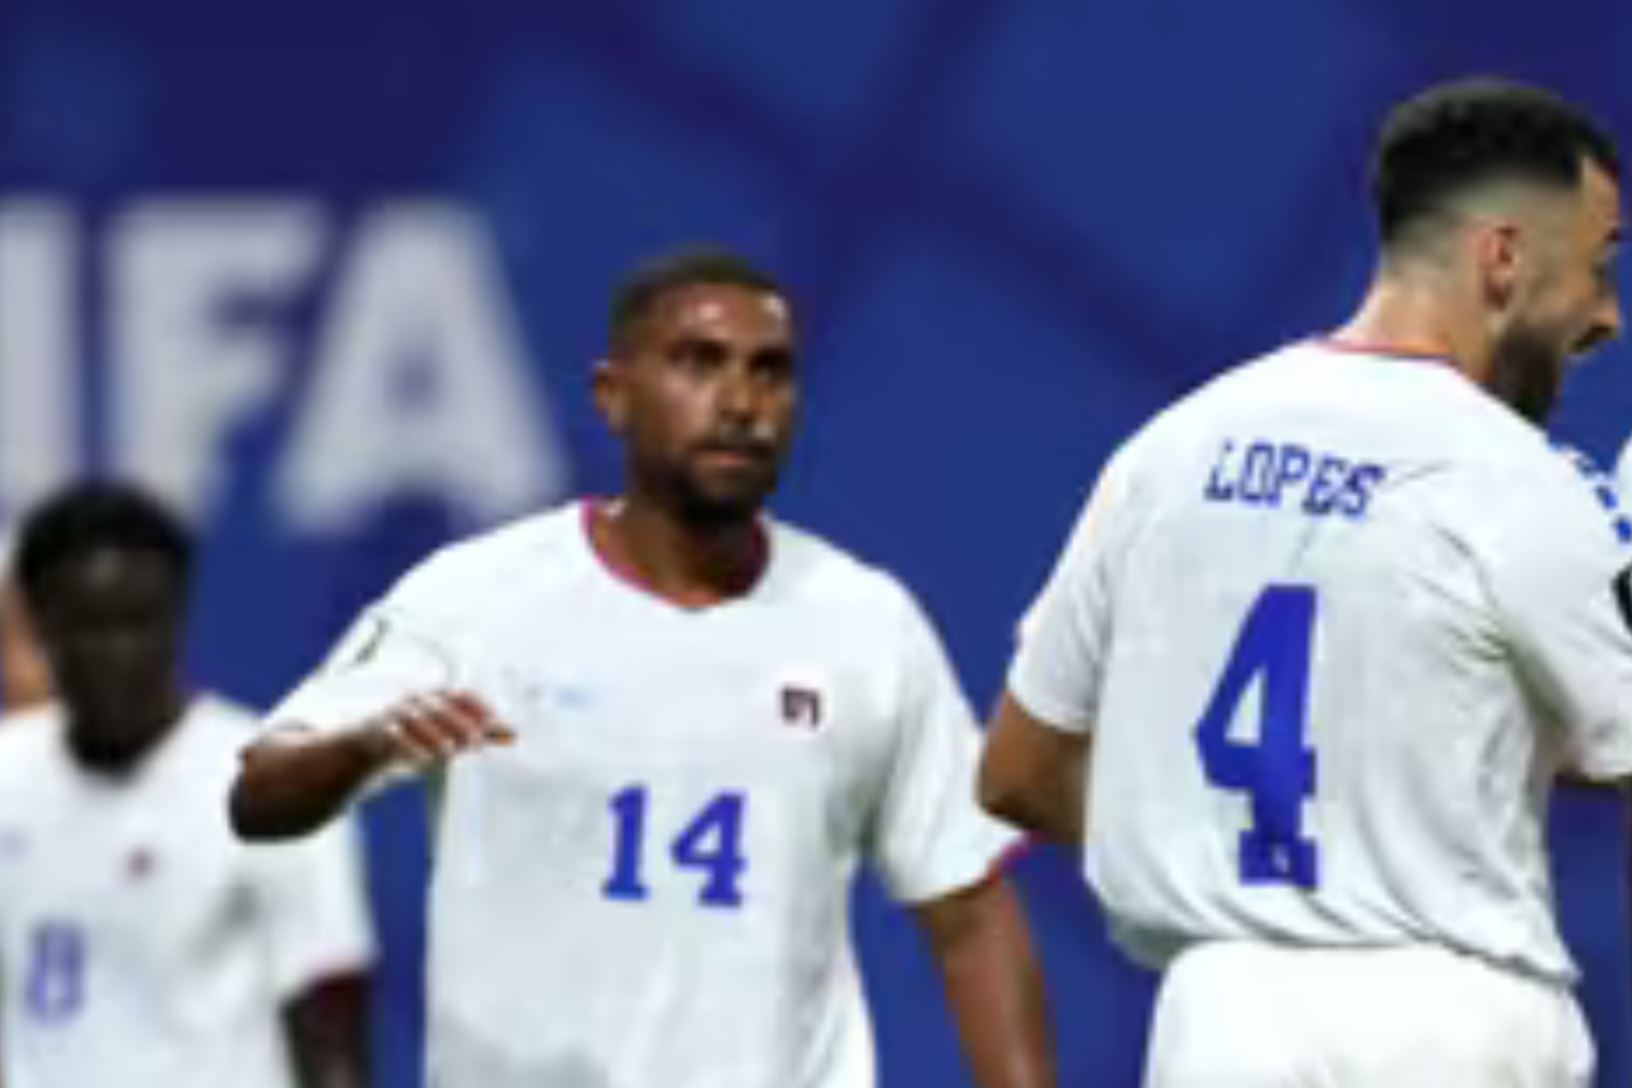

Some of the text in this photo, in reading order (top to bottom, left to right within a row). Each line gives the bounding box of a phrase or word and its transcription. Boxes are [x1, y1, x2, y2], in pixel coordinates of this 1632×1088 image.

[1204, 440, 1384, 518] LOPES
[1193, 584, 1318, 890] 4
[603, 785, 746, 907] 14
